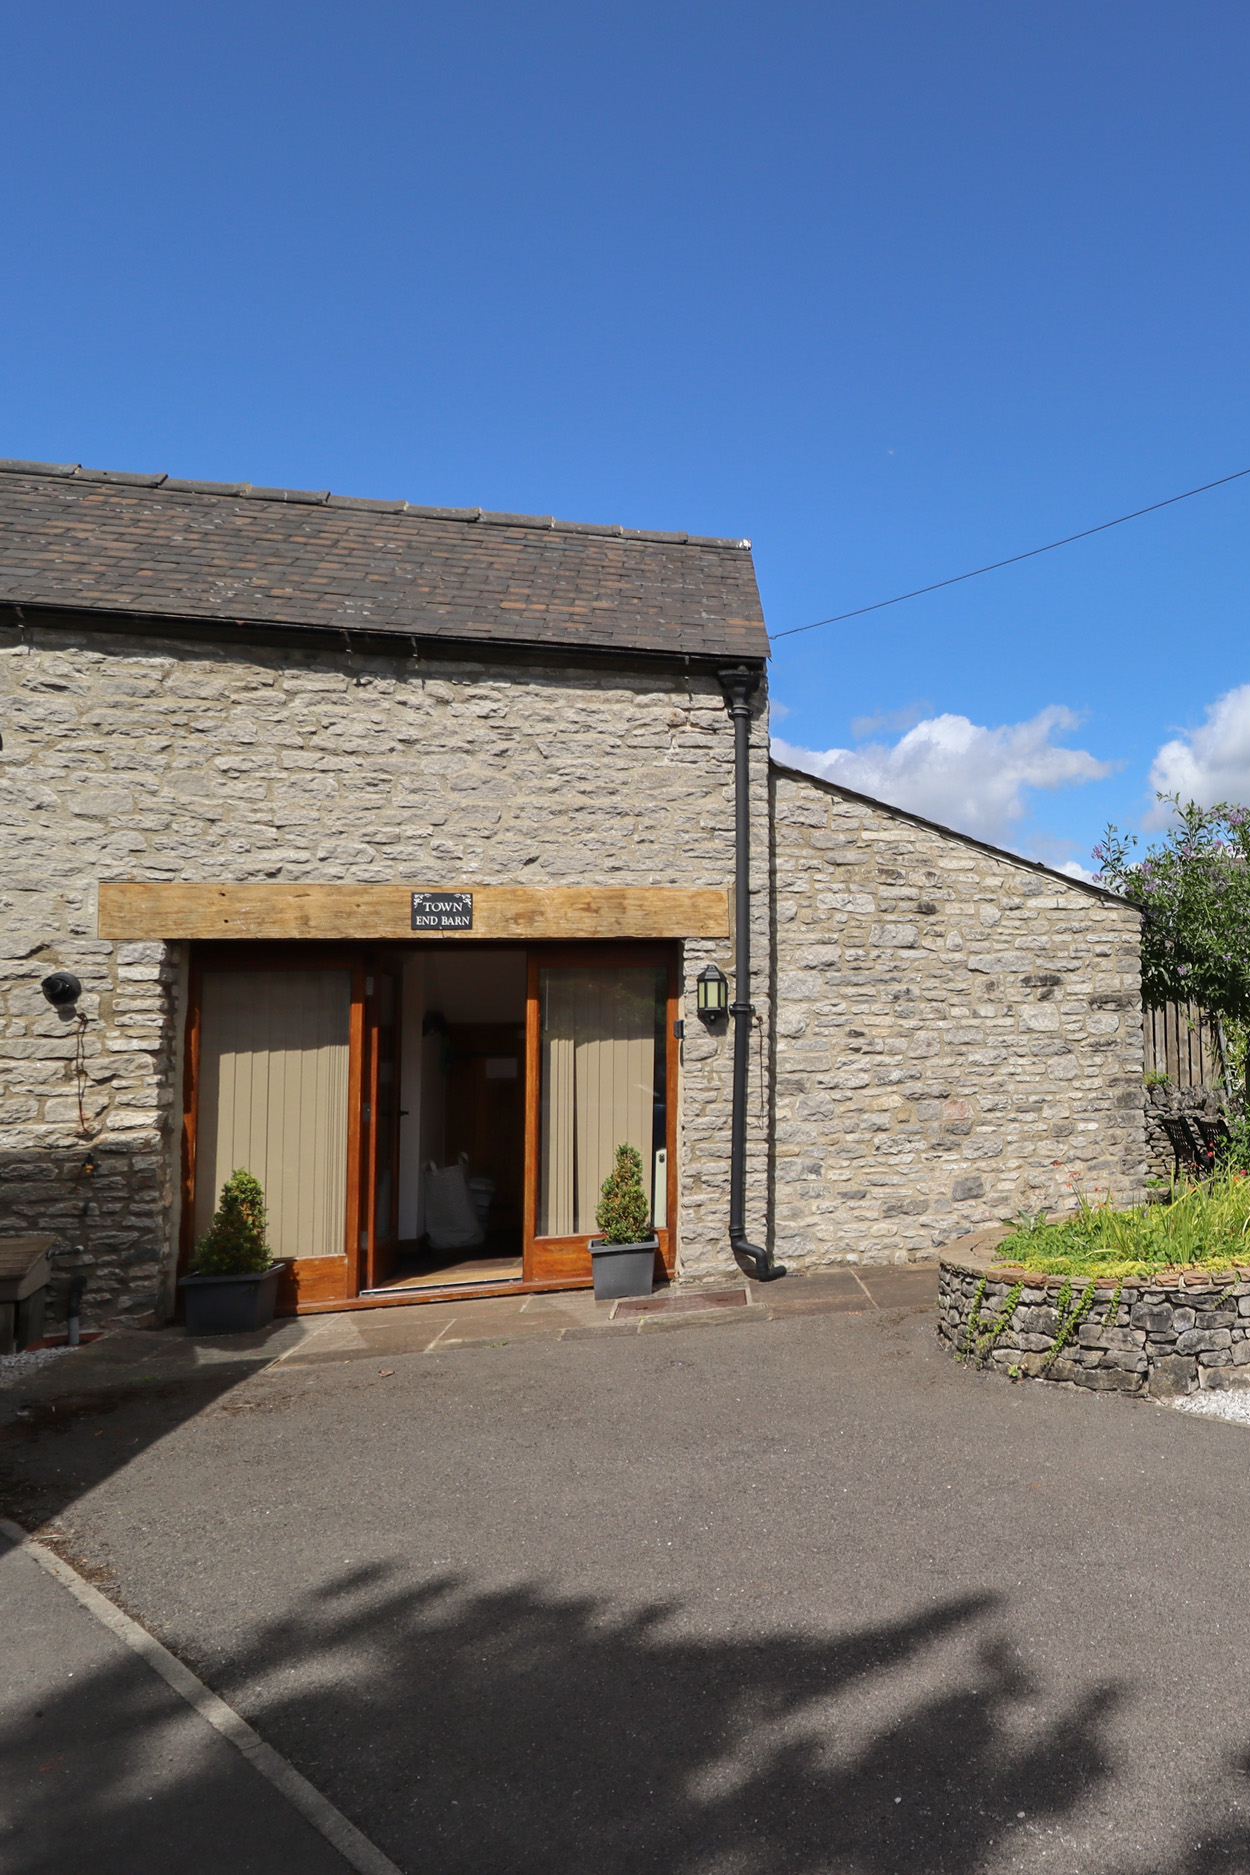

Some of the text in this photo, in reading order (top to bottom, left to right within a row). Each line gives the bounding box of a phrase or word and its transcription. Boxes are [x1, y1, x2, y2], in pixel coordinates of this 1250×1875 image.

[423, 902, 463, 912] TOWN
[416, 915, 470, 926] END BARN
